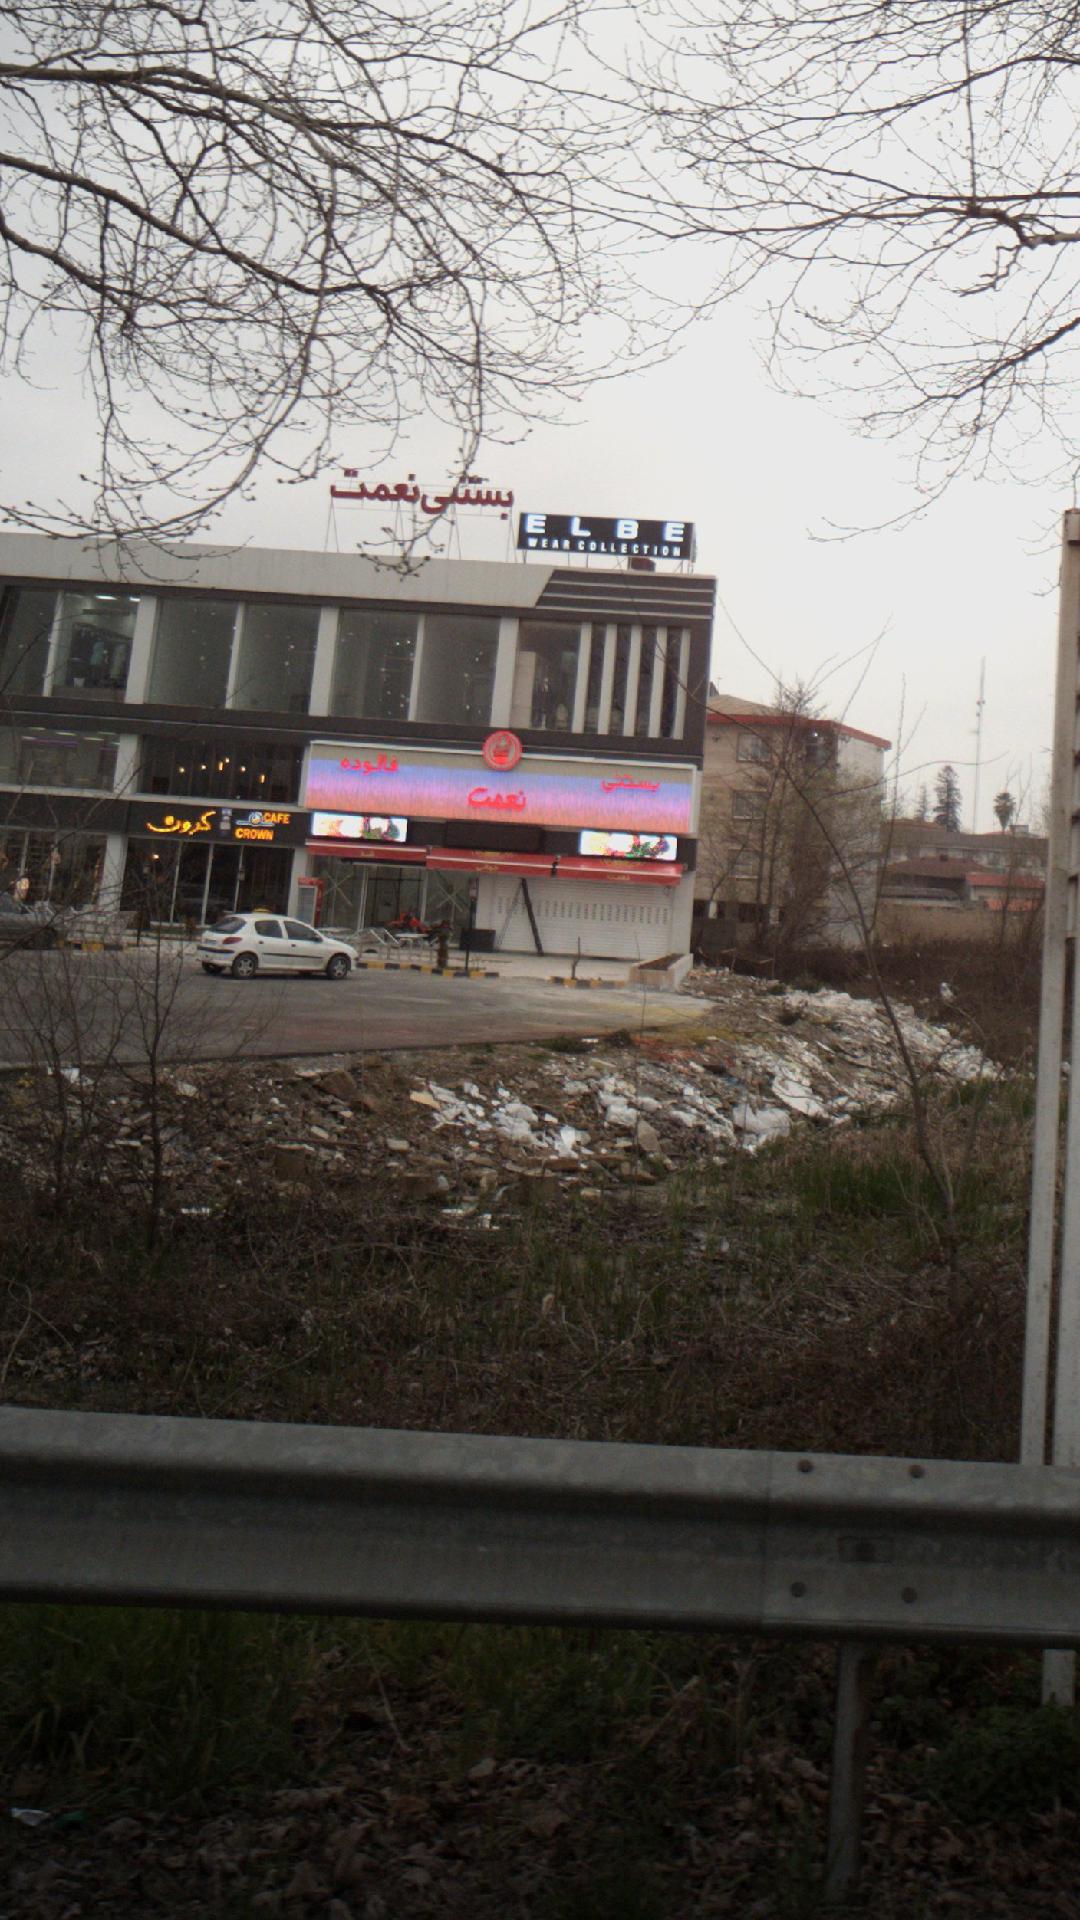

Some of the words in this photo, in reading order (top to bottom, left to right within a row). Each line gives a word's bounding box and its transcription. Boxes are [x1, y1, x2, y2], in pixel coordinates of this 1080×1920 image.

[330, 469, 420, 502] نعمت
[421, 475, 514, 521] بستنی
[526, 513, 685, 543] ELBE
[528, 537, 571, 549] WEAR
[578, 540, 681, 557] COLLECTION
[340, 753, 399, 776] فالوده
[467, 787, 527, 812] نعمت
[262, 811, 291, 825] CAFE
[235, 828, 274, 841] CROWN
